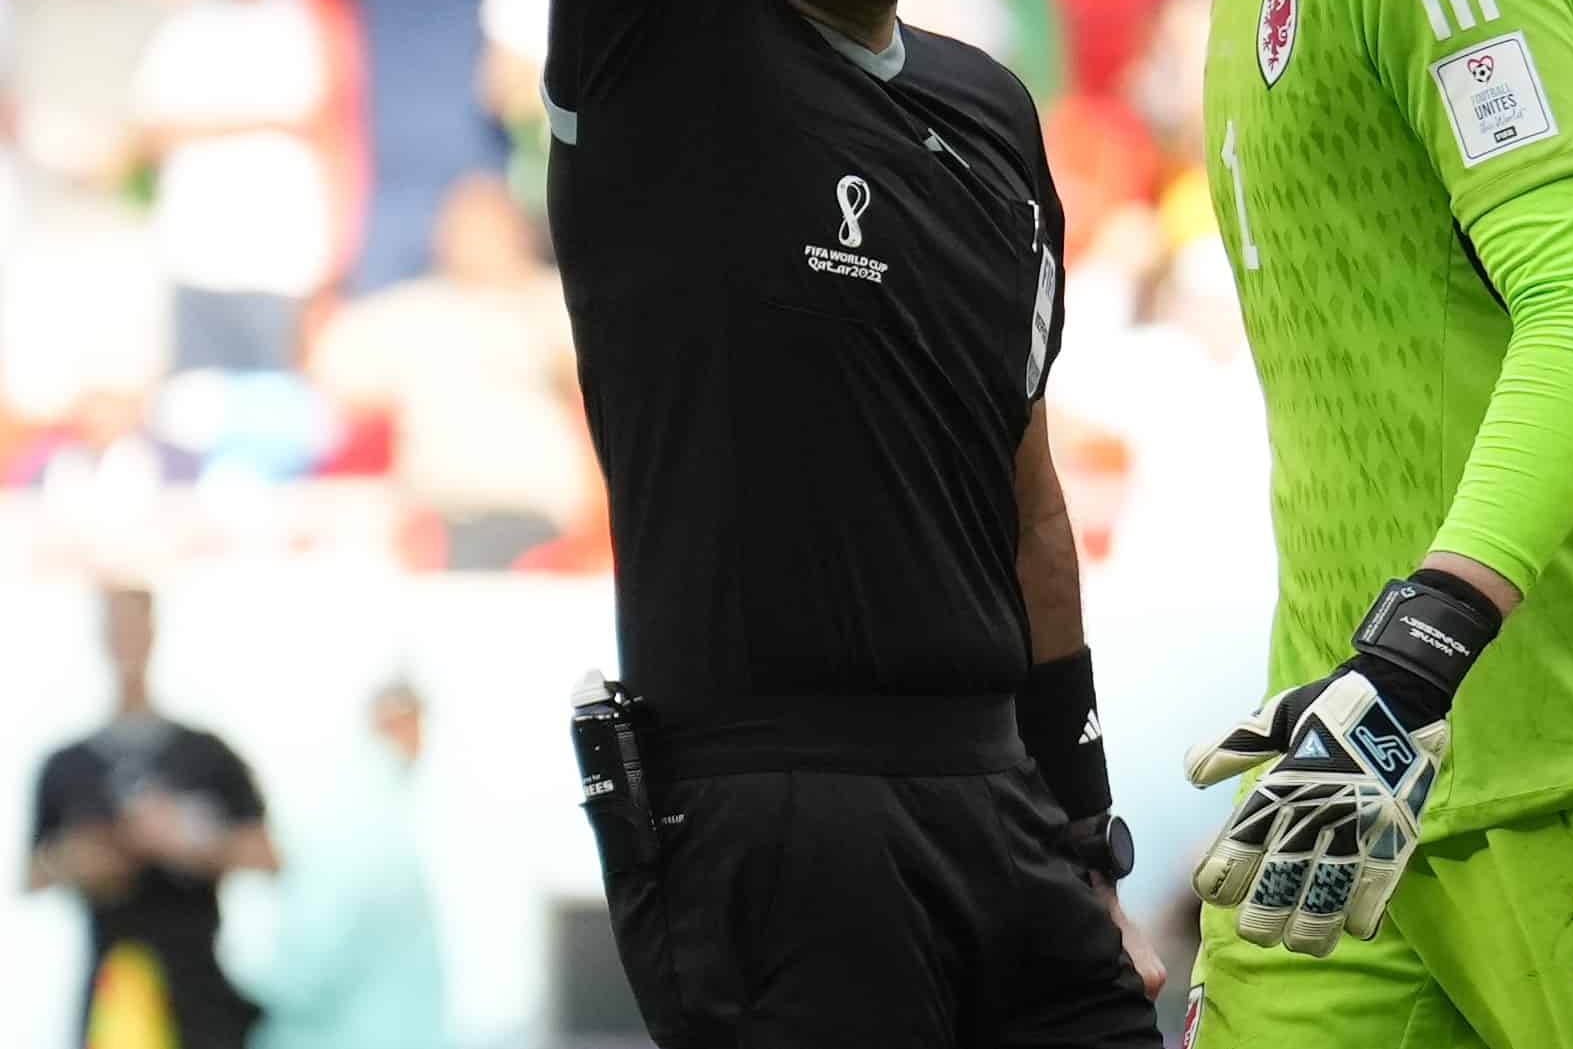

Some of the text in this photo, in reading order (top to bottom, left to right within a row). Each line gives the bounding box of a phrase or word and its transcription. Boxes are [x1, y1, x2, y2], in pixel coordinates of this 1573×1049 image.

[1474, 94, 1517, 120] UNITES
[1221, 119, 1260, 270] 1
[804, 245, 888, 273] FIFA WORLD CUP
[1409, 628, 1454, 657] WAYNE
